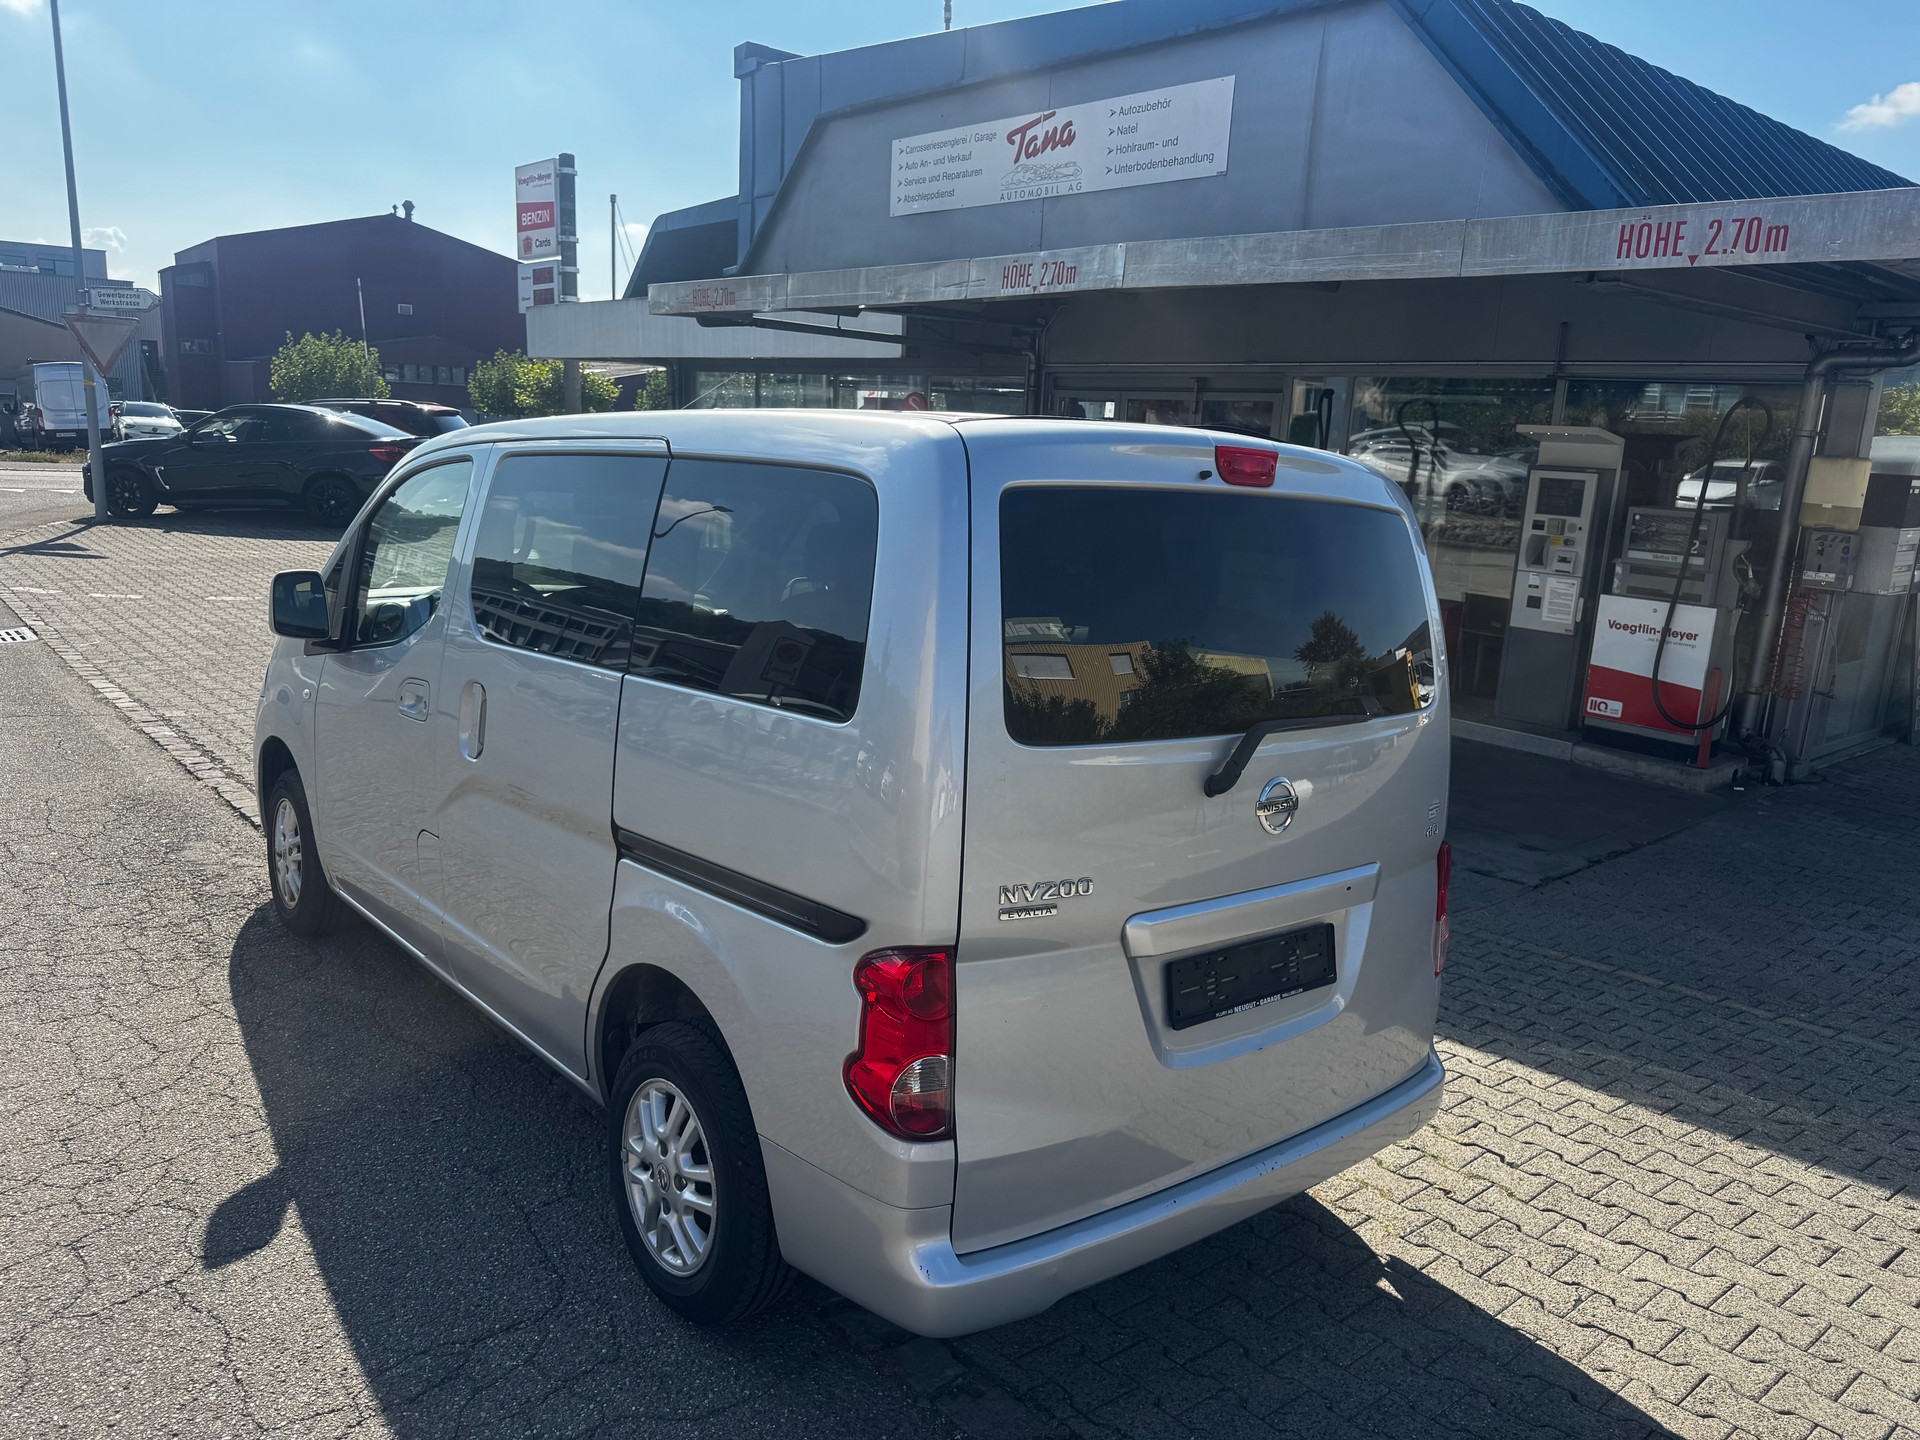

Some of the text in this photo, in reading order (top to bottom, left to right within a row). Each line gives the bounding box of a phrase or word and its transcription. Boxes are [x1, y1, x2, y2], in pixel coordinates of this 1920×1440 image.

[1118, 98, 1172, 117] Autozubehör
[974, 131, 997, 143] Garage
[1006, 110, 1076, 165] Tana
[1116, 122, 1139, 136] Natel
[1115, 136, 1179, 155] Hohlraum- und
[904, 151, 972, 171] Auto An- und Verkauf
[1114, 152, 1215, 175] Unterbodenbehandlung
[903, 168, 983, 187] Service und Reparaturen
[903, 188, 955, 203] Abschleppdienst
[1000, 182, 1082, 201] AUTOMOBIL AG
[521, 209, 550, 226] BENZIN
[535, 238, 552, 248] Cards
[1616, 215, 1688, 259] HÖHE
[1001, 259, 1033, 290] HÖHE
[97, 291, 141, 300] Gewerbezone
[99, 298, 140, 307] Werkstrasse
[1690, 540, 1700, 554] 2
[1000, 877, 1094, 905] NV200
[1007, 907, 1053, 919] EVALIA
